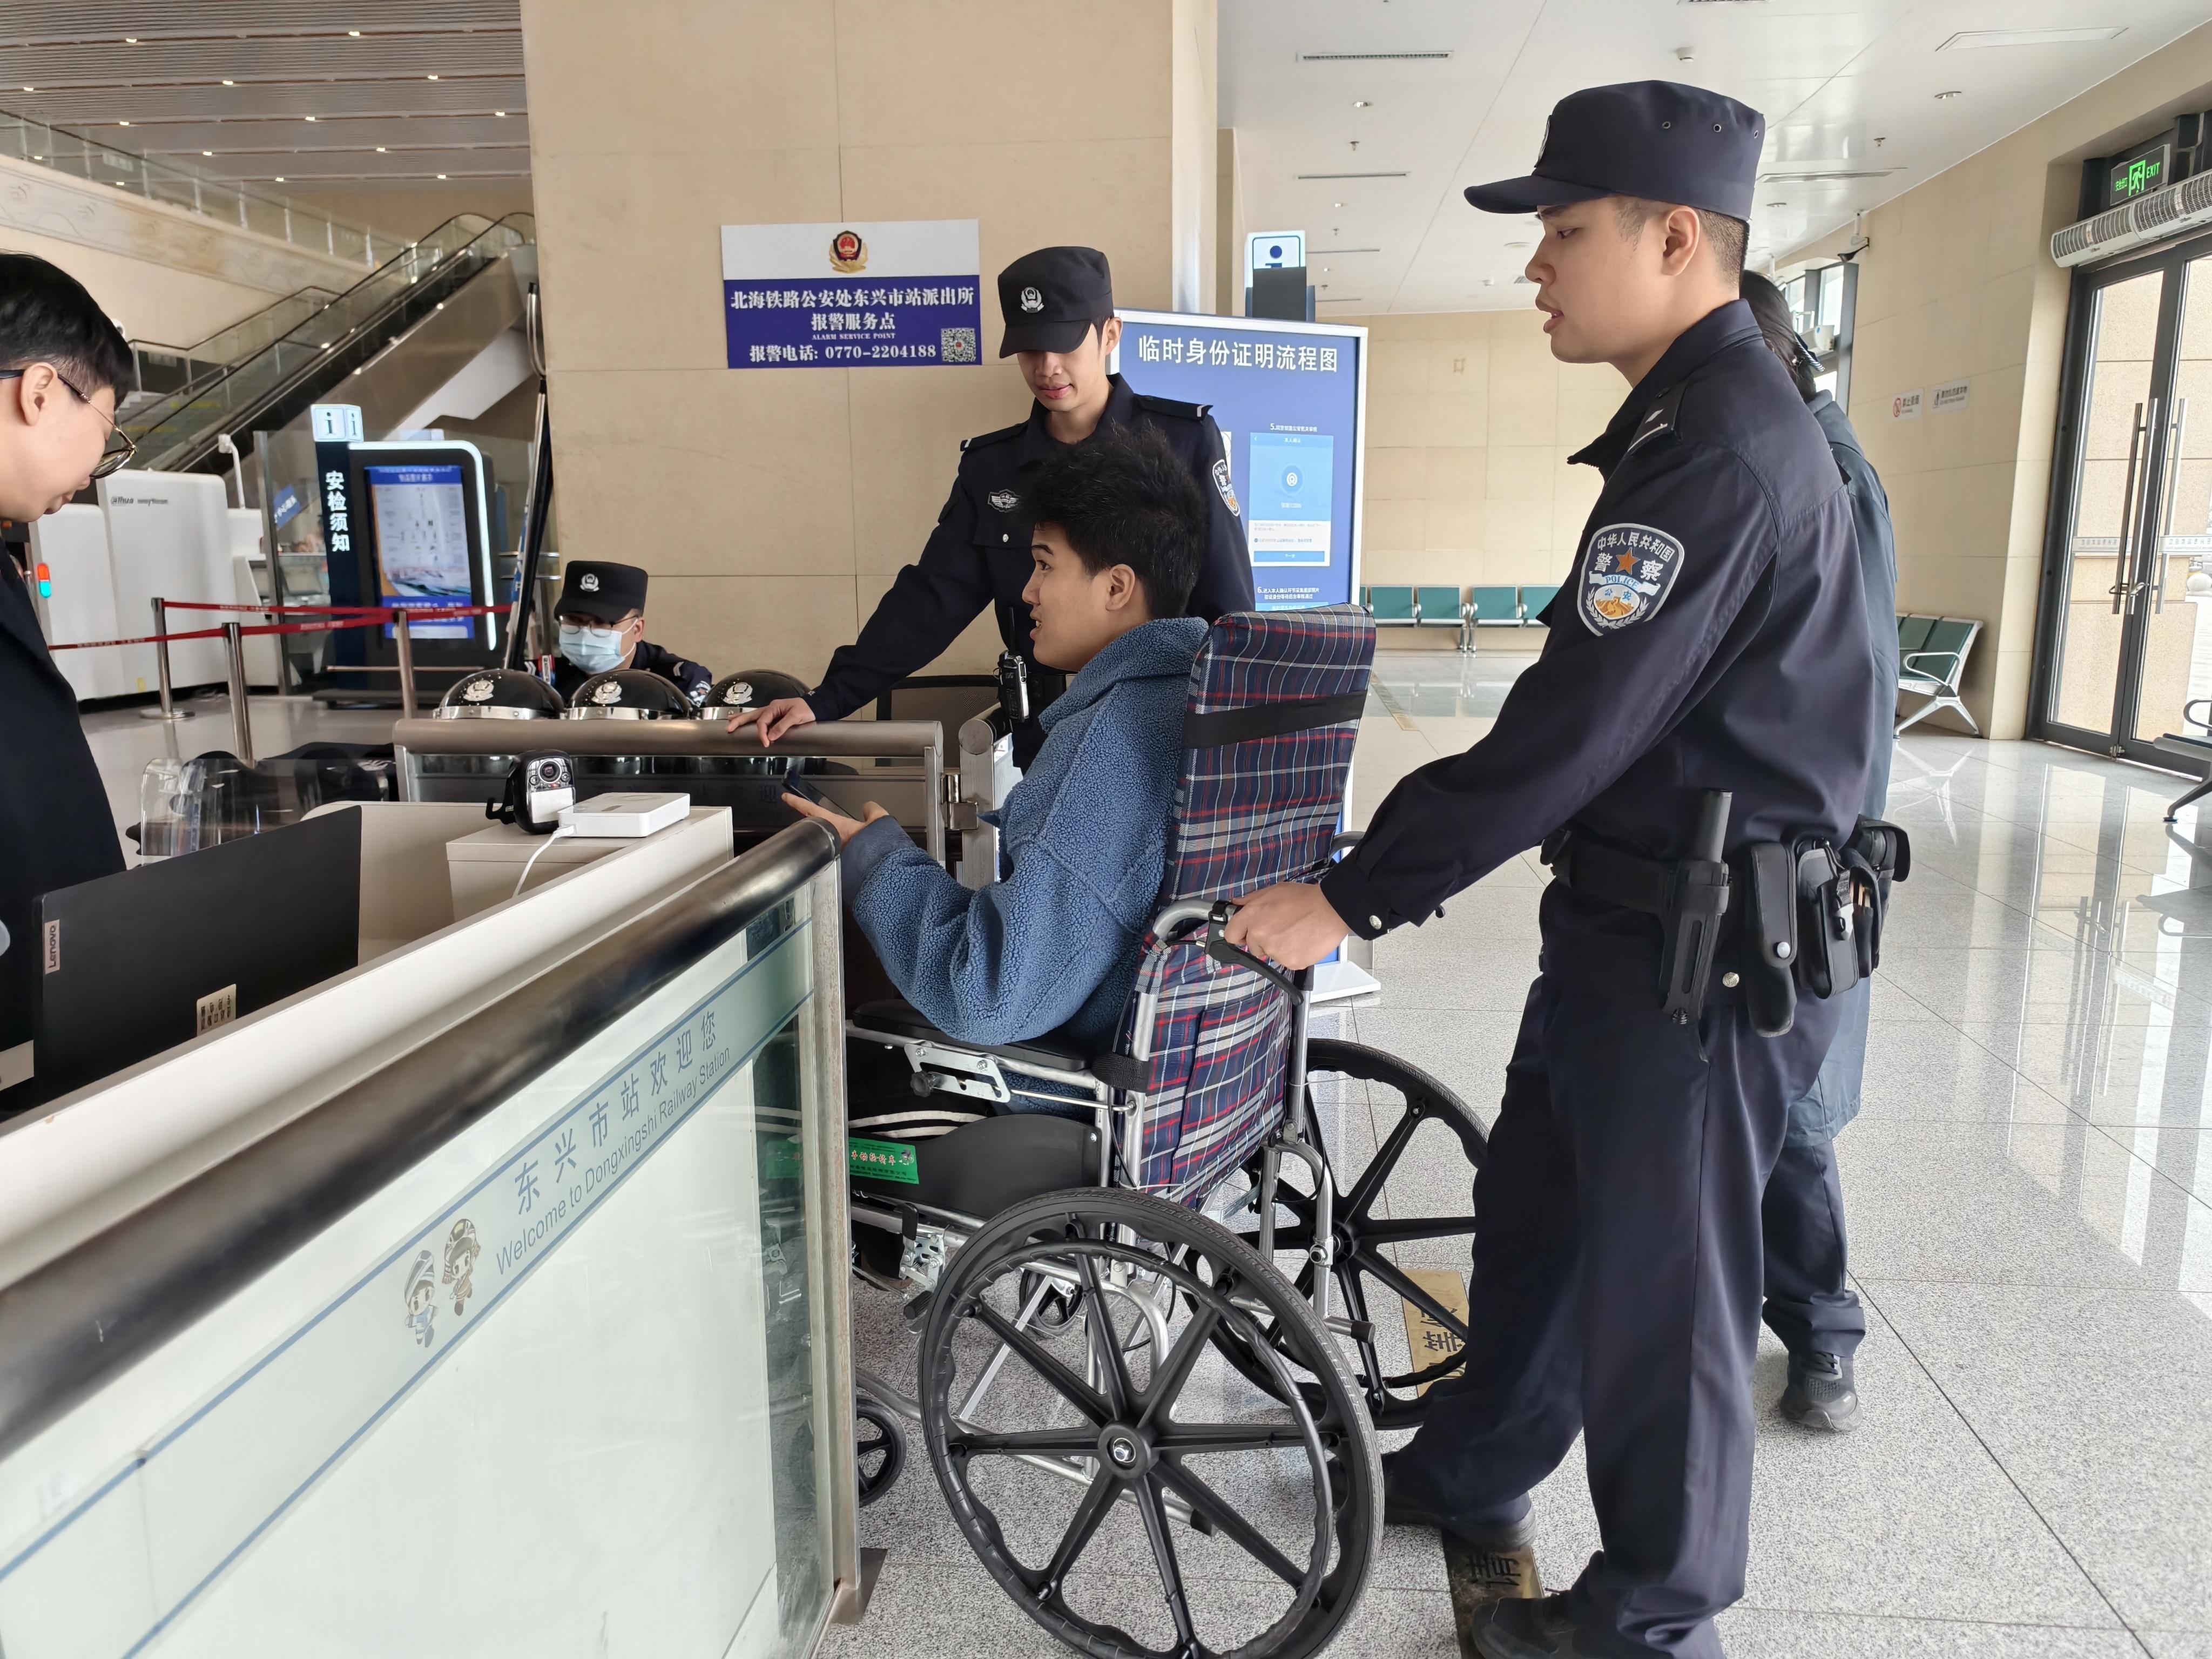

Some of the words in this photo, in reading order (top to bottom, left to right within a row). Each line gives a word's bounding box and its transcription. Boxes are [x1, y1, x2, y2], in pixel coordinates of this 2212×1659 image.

[2146, 162, 2160, 179] EXIT
[731, 287, 974, 309] 北海铁路公安处东兴市站派出所
[811, 312, 896, 331] 报警服务点
[825, 345, 936, 359] 0770-2204188
[1138, 335, 1338, 372] 临时身份证明流程图
[326, 470, 350, 552] 安检须知
[1597, 531, 1675, 563] 中华人民共和国
[1606, 574, 1640, 590] POLICE
[48, 925, 57, 968] Lenovo
[515, 1010, 716, 1215] 东兴市站欢迎您
[496, 1200, 567, 1275] Welcome
[570, 1184, 582, 1208] to
[585, 1109, 657, 1194] Dongxingshi
[659, 1076, 698, 1124] Railway
[699, 1047, 730, 1085] Station
